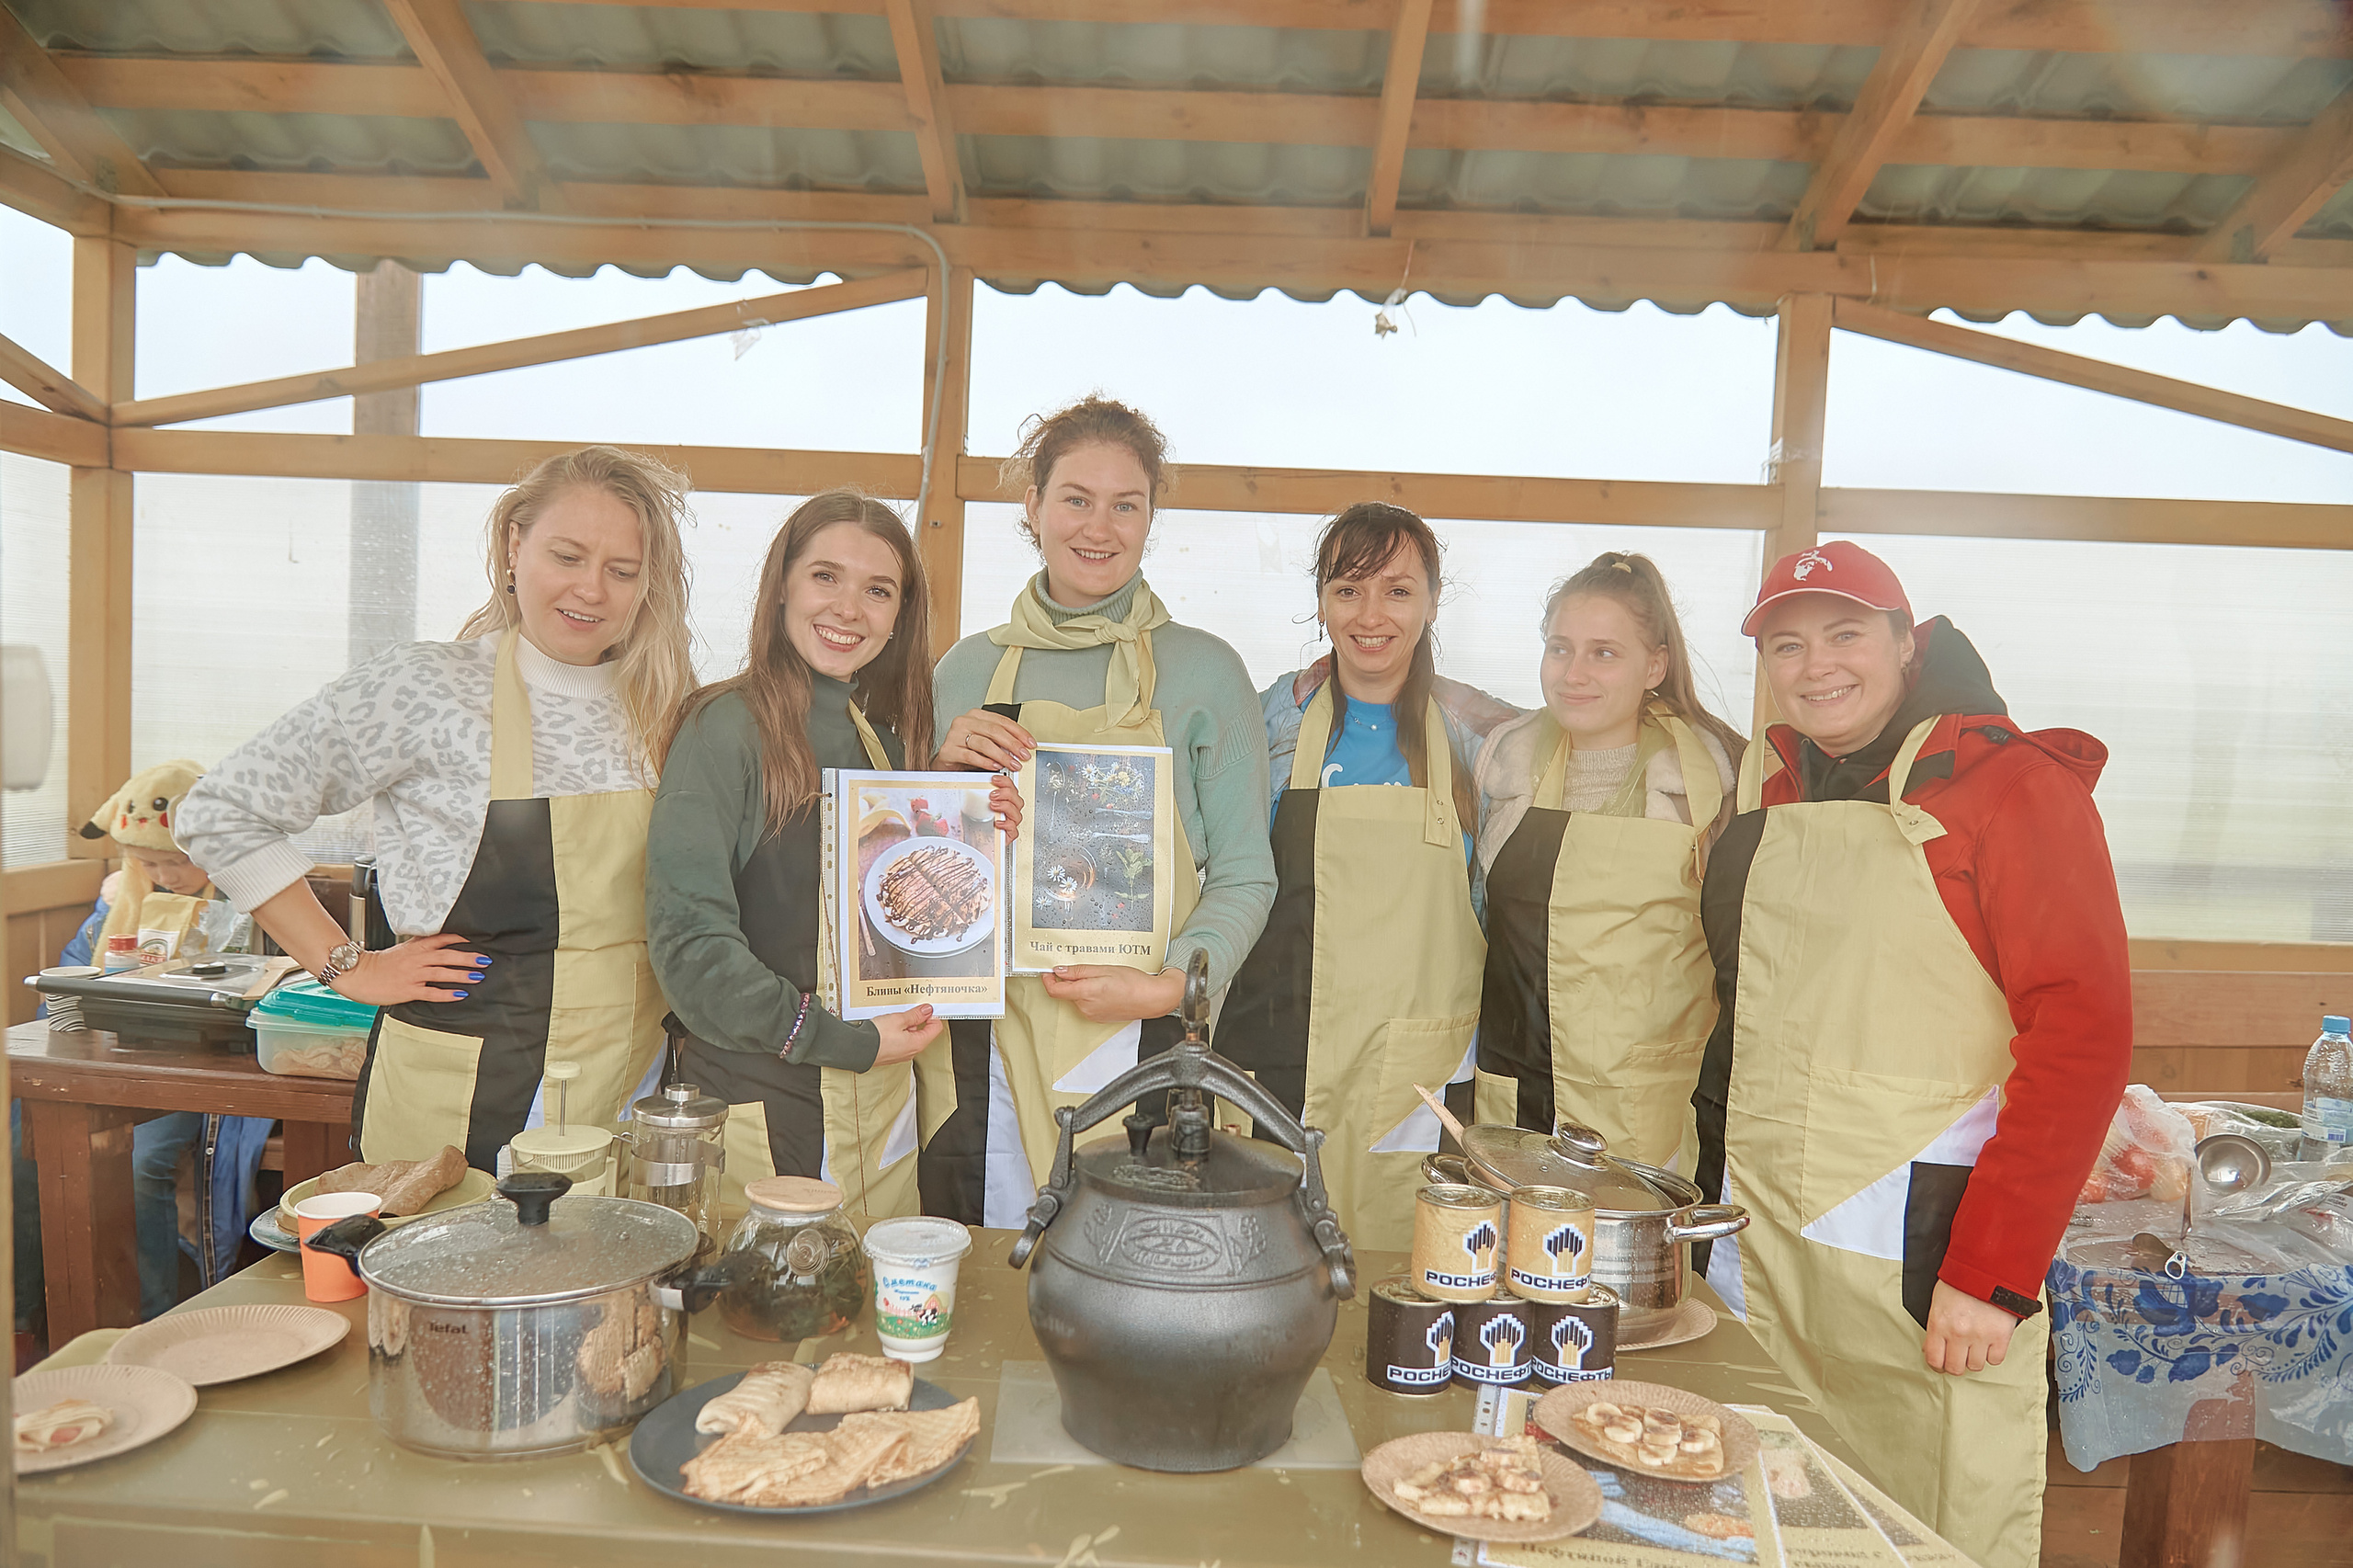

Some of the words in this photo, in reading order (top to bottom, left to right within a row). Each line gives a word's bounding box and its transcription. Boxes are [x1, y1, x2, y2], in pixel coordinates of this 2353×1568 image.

[1029, 941, 1053, 952] Чай
[1065, 945, 1115, 955] травами
[1119, 944, 1152, 955] ЮТМ
[867, 986, 902, 997] Блины
[904, 984, 988, 996] «Нефтяночка»
[882, 1276, 937, 1291] Сметана
[427, 1322, 468, 1334] Tefal
